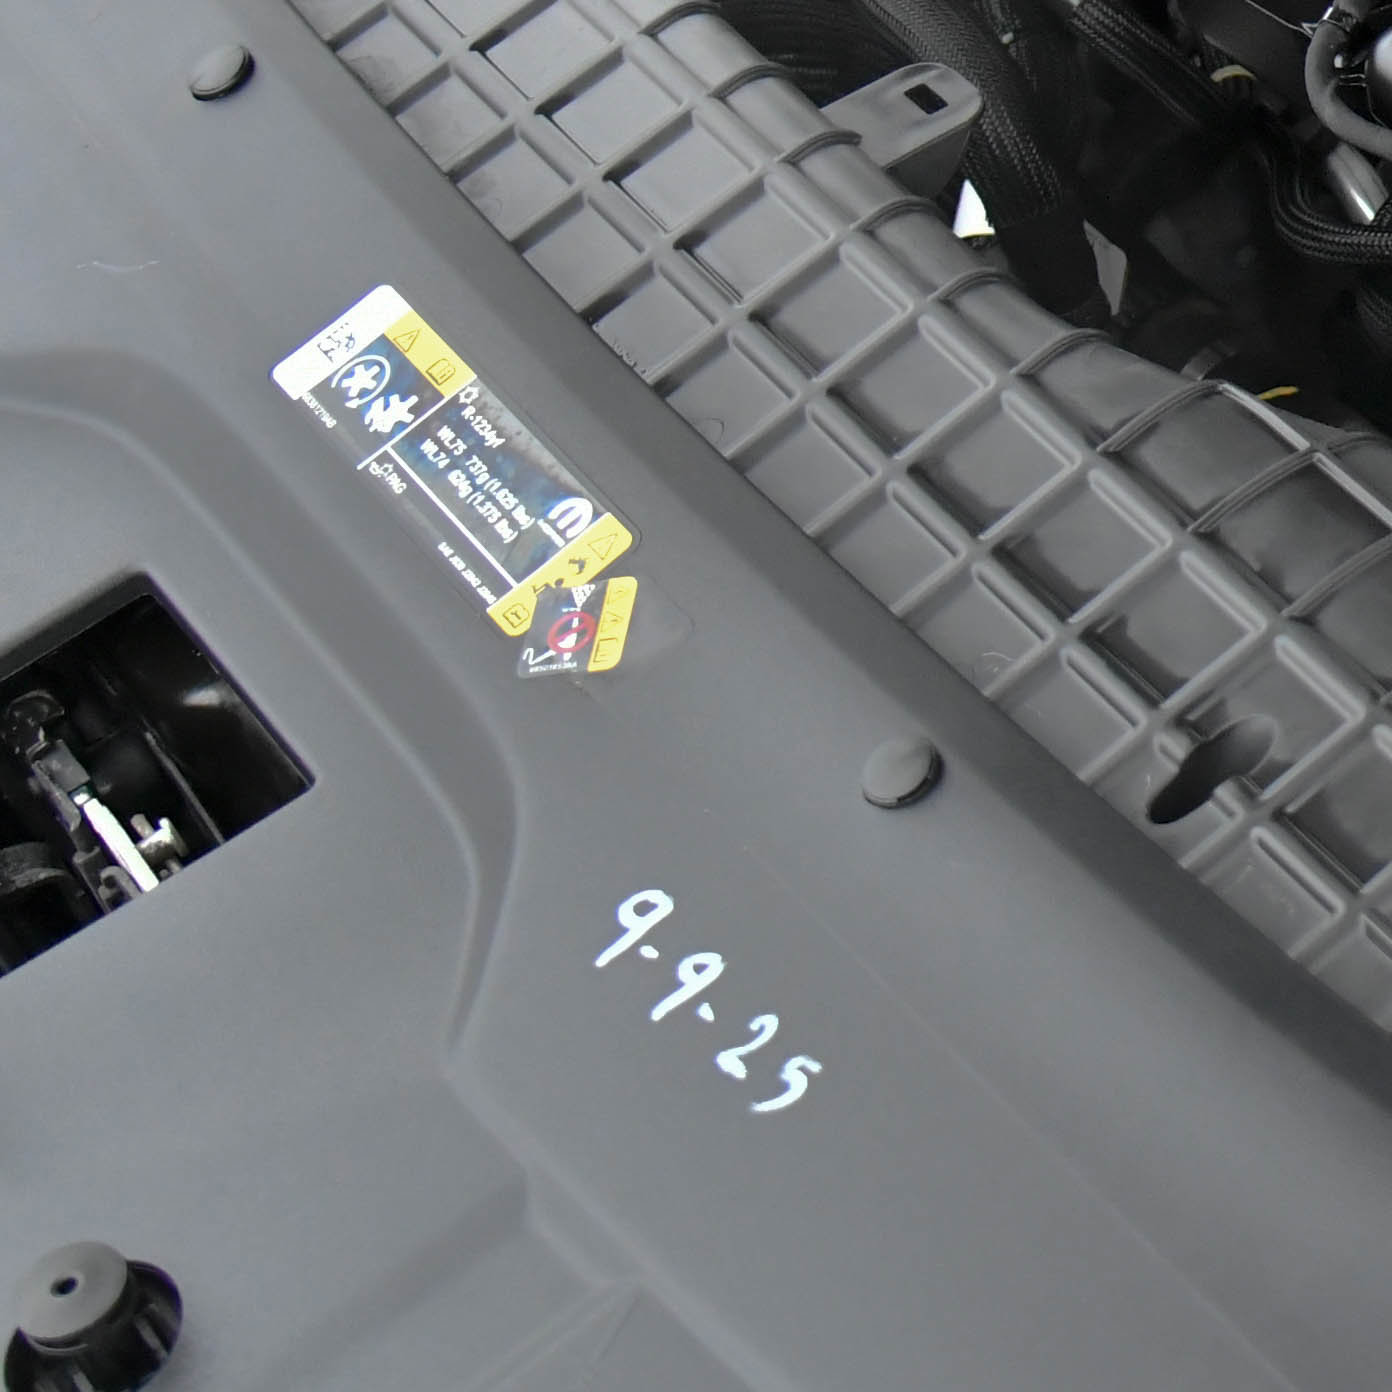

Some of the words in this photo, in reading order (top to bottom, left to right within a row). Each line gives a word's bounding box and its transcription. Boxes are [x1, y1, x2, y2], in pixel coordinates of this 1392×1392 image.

[460, 405, 506, 449] R-1234yf
[420, 437, 451, 469] WL74
[466, 491, 502, 524] (1.375
[436, 424, 468, 456] WL75
[465, 454, 491, 485] 737g
[385, 469, 408, 496] PAG
